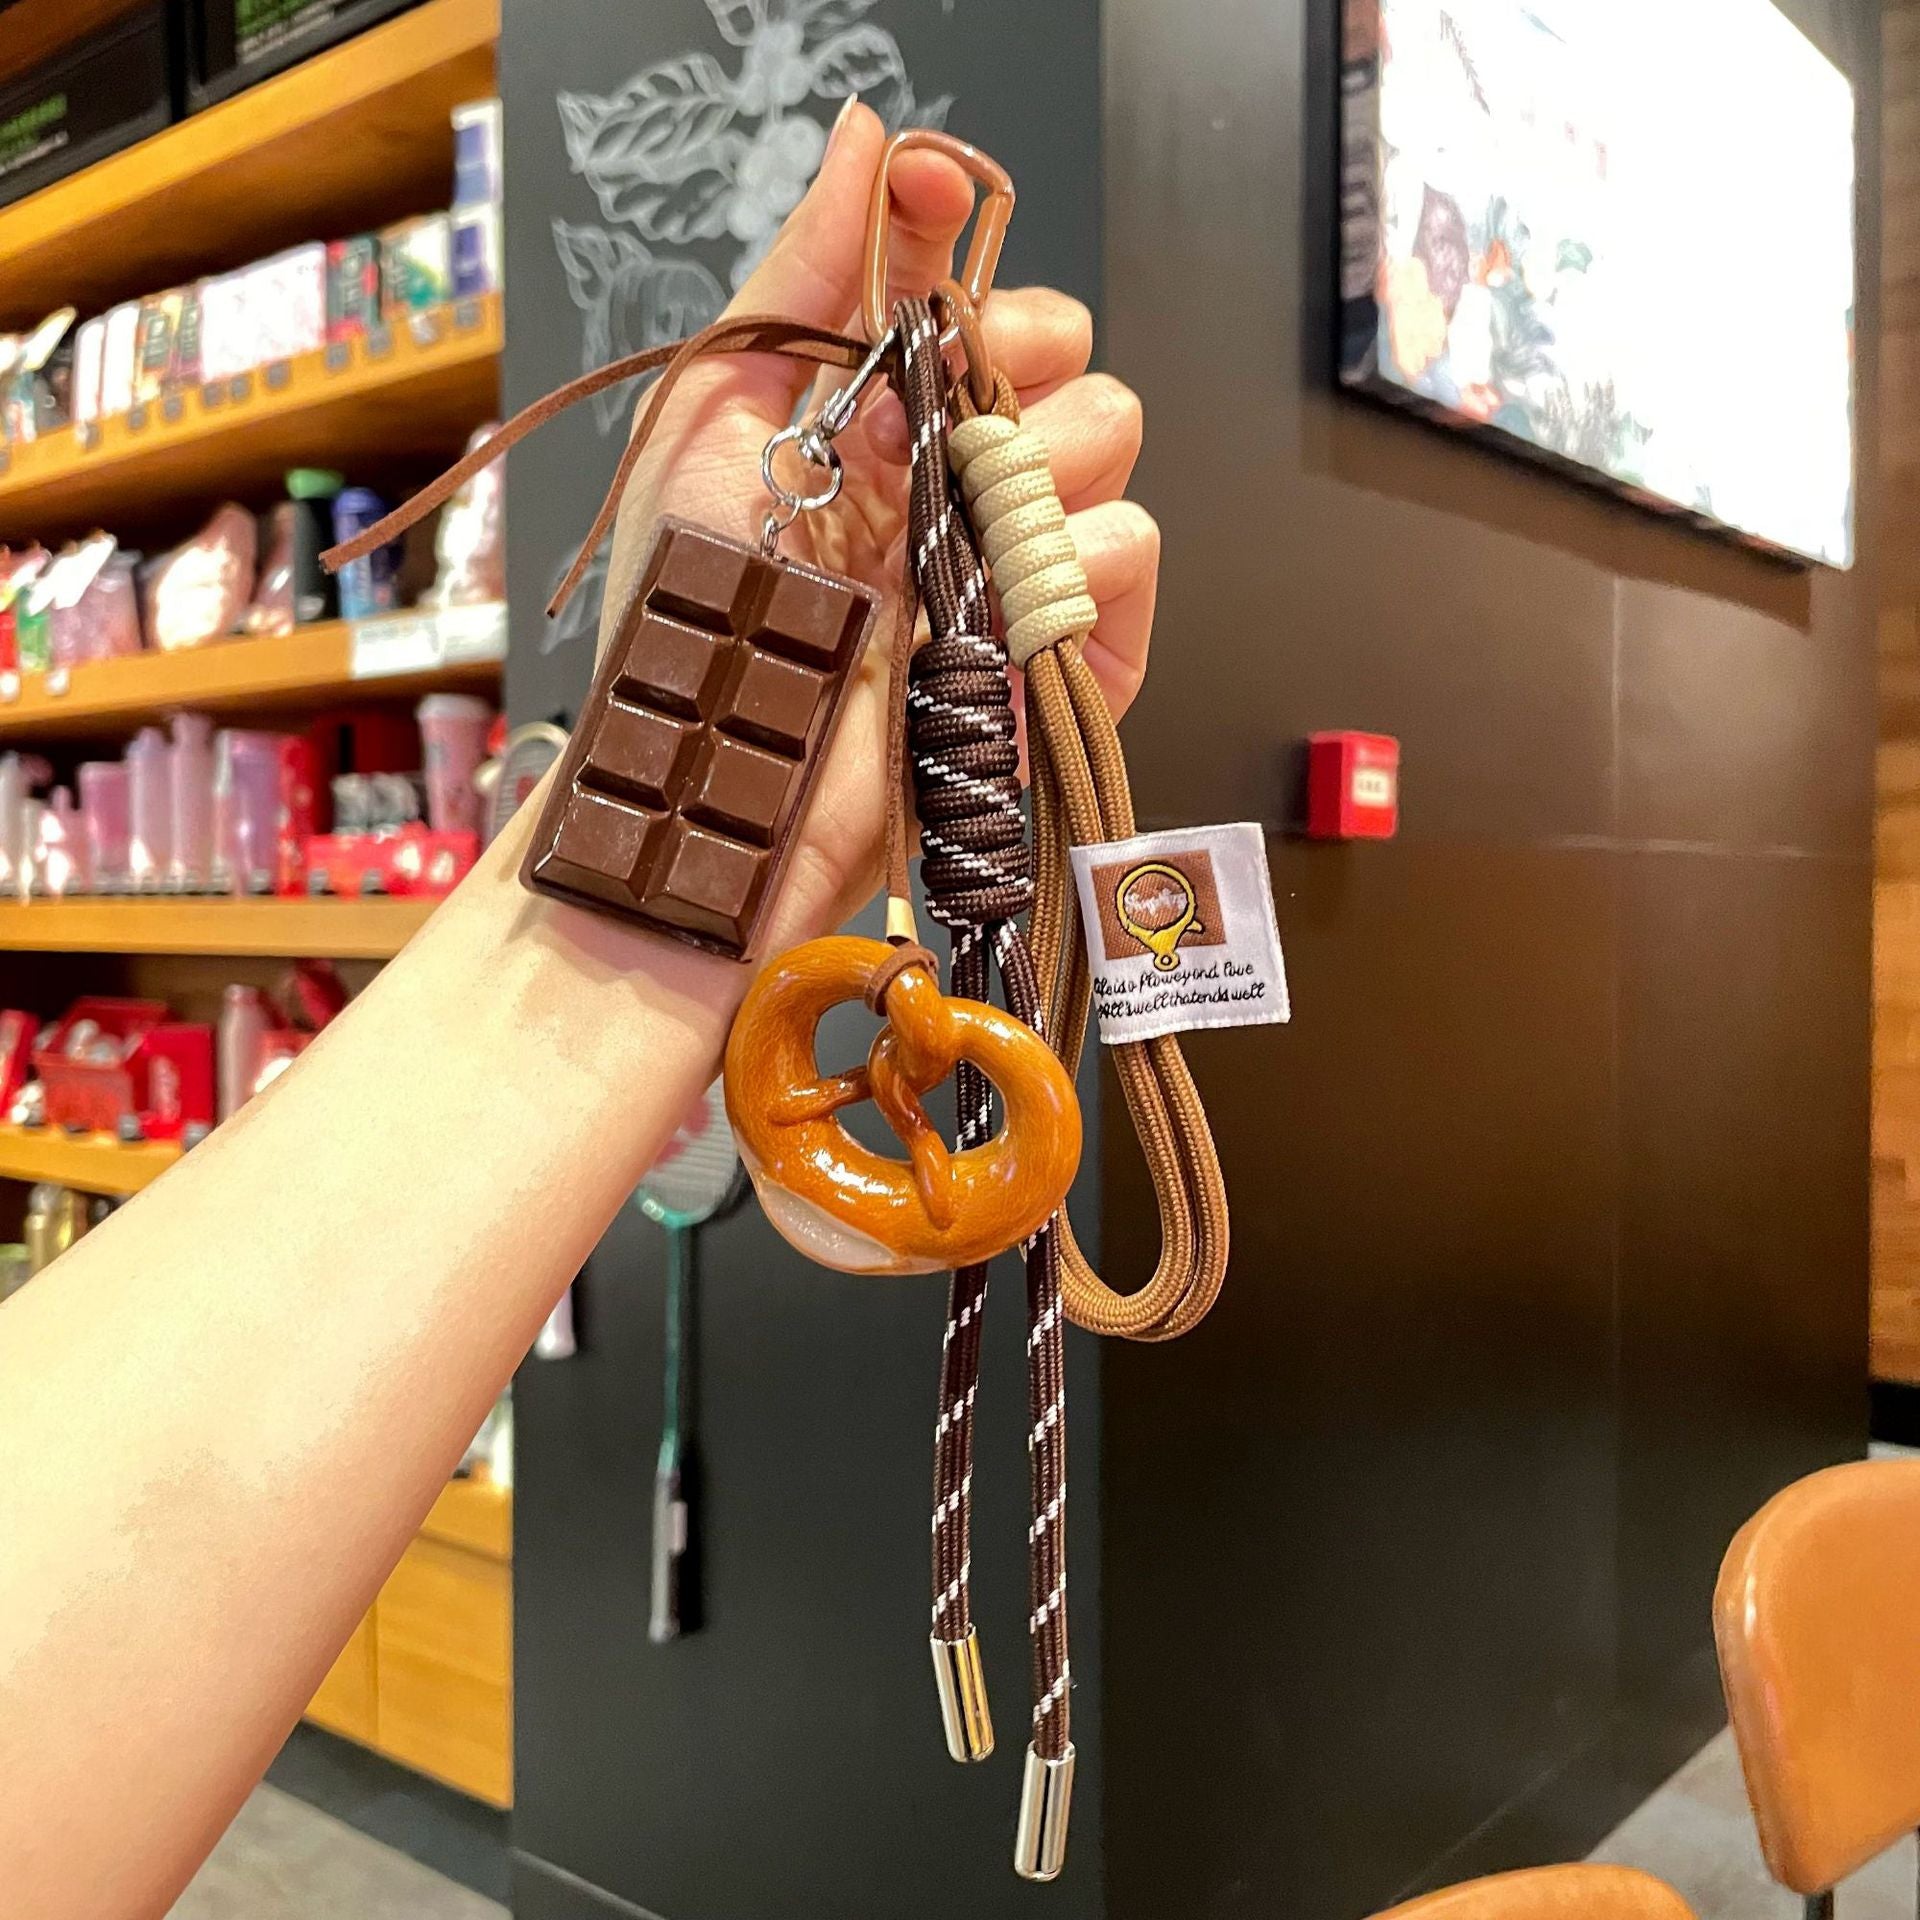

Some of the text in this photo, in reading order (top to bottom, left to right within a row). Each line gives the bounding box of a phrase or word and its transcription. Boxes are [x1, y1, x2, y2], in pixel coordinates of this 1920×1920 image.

[1223, 961, 1255, 978] love
[1133, 992, 1170, 1015] well
[1230, 982, 1266, 1002] well
